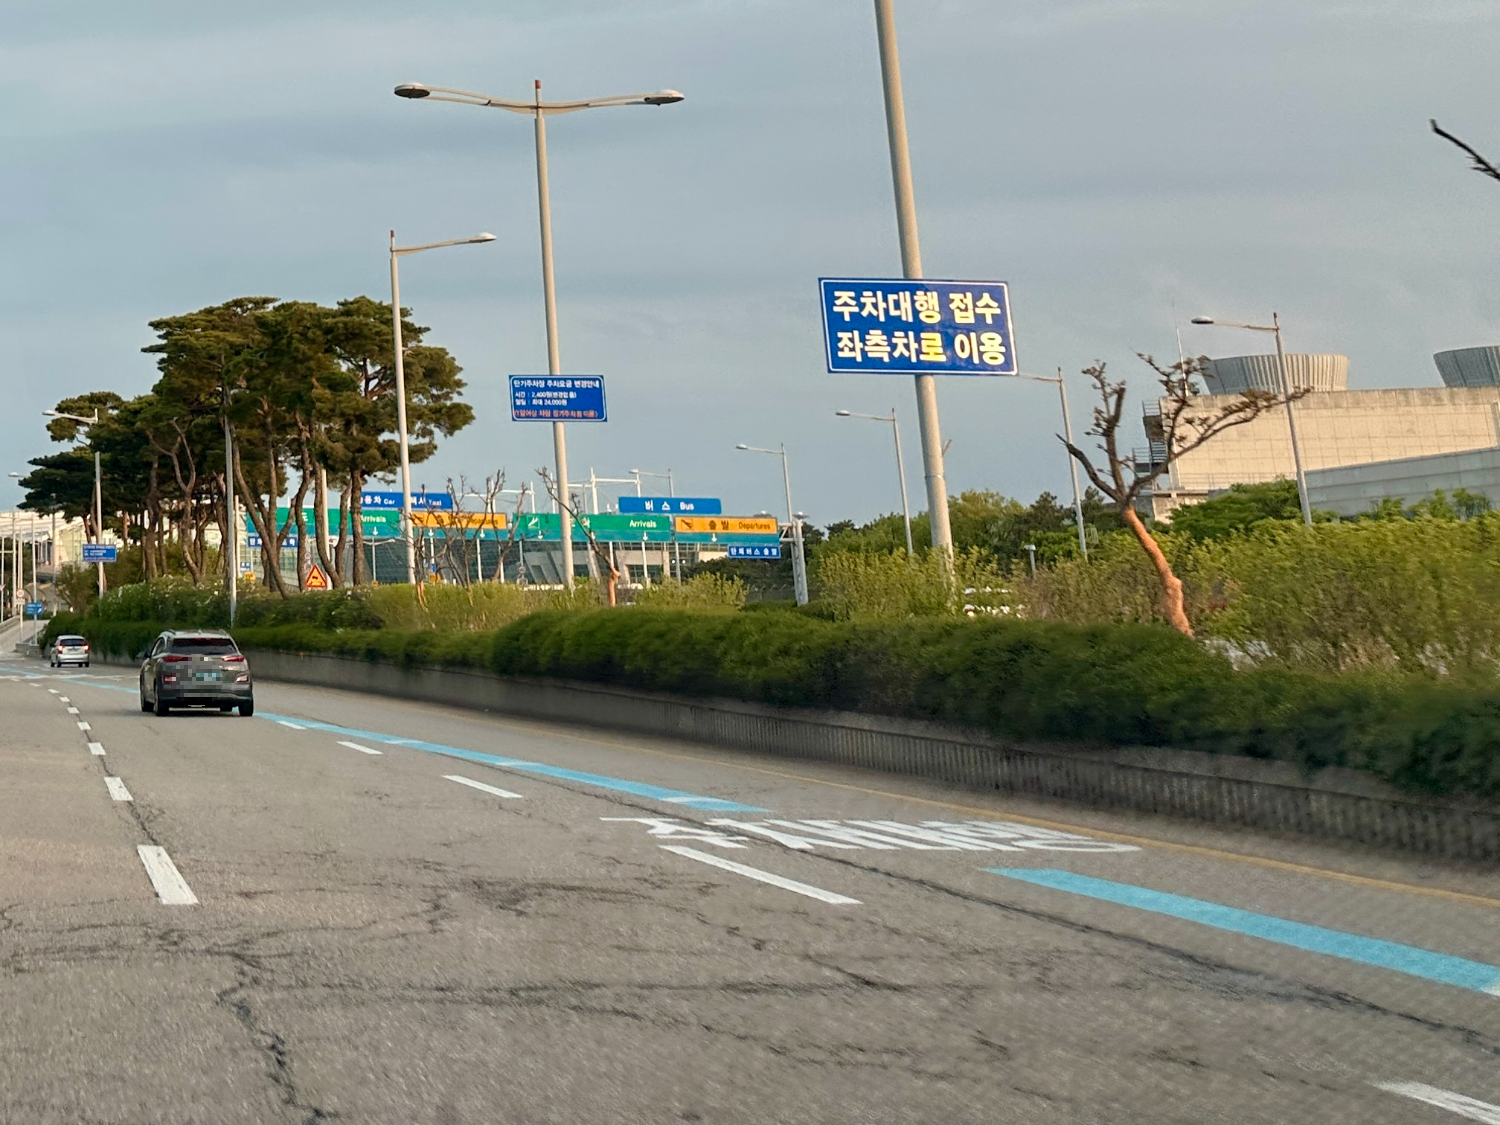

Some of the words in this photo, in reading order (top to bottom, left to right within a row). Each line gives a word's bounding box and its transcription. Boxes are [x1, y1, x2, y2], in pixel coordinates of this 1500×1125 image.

[833, 290, 941, 324] 주차대행
[948, 291, 1001, 324] 접수
[836, 329, 947, 363] 좌측차로
[954, 331, 1006, 365] 이용
[679, 501, 695, 511] Bus
[629, 519, 657, 528] Arrivals
[738, 521, 771, 531] Departures
